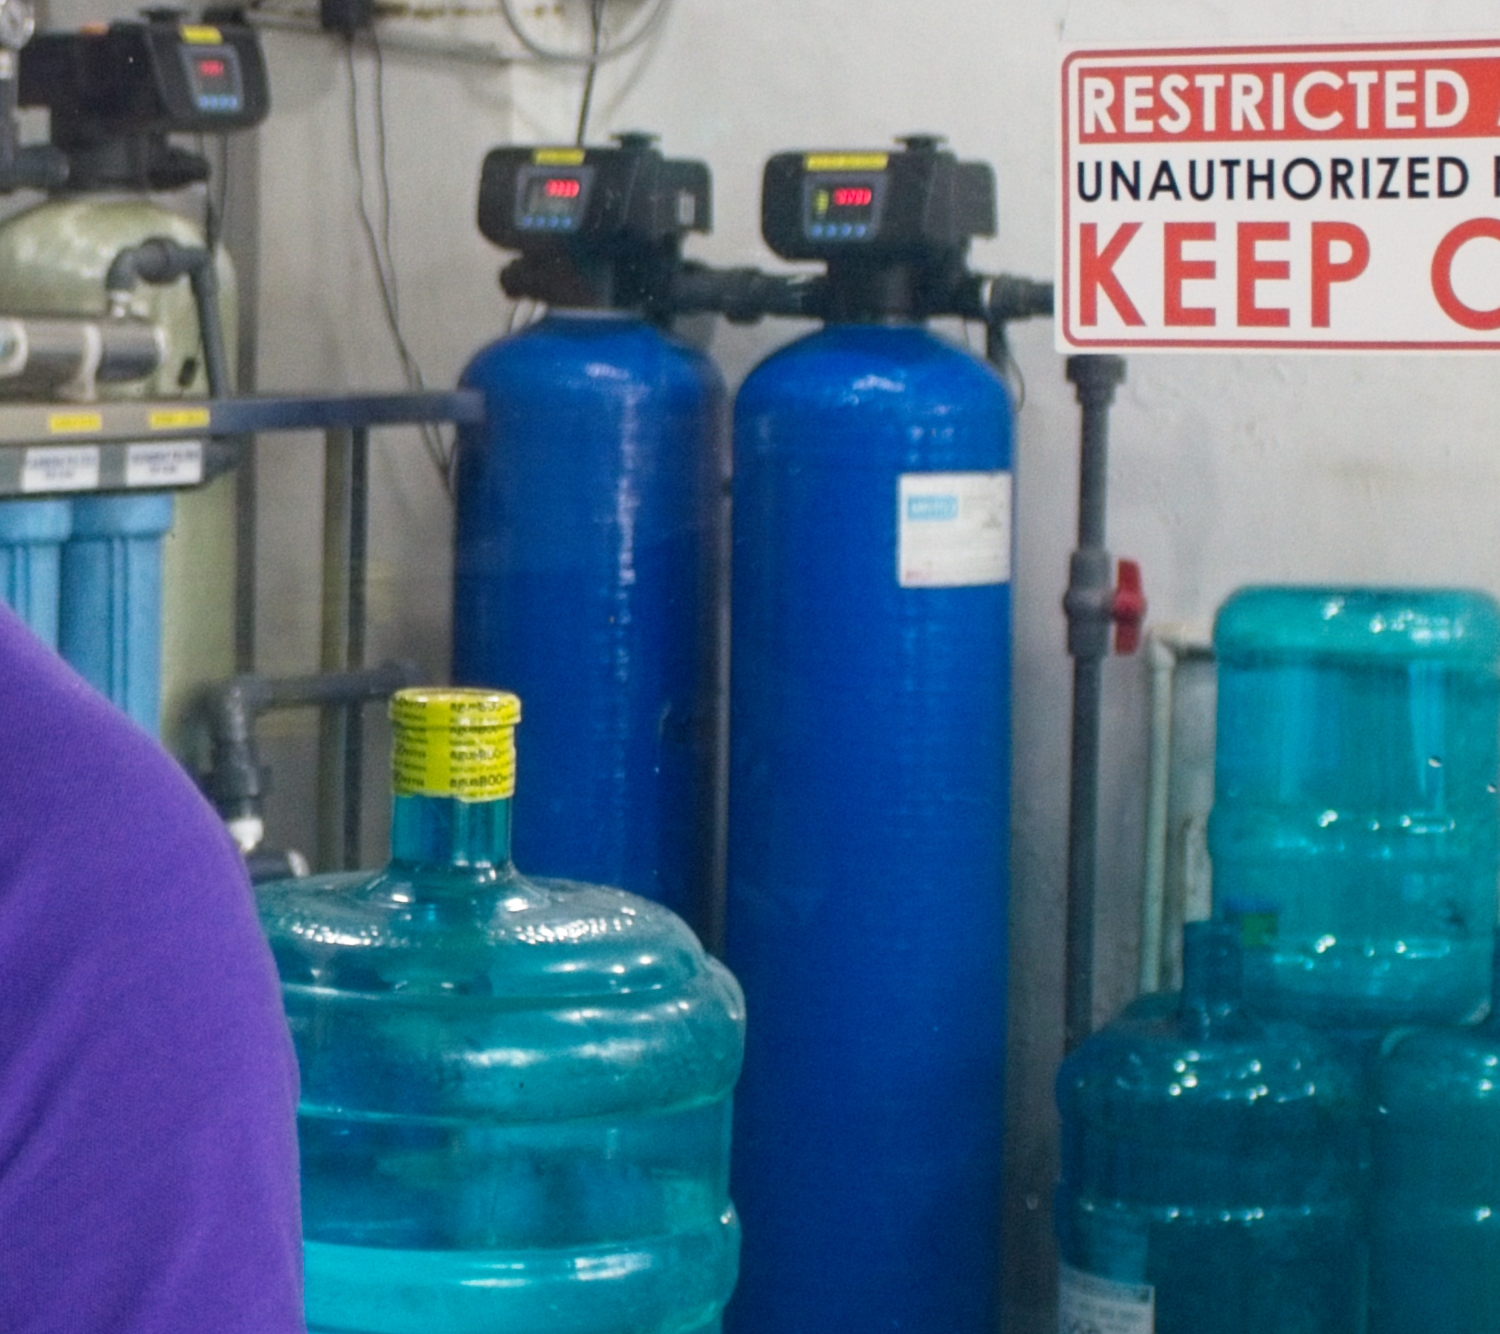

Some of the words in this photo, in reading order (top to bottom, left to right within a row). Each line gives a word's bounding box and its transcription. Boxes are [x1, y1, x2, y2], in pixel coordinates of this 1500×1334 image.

[1082, 70, 1470, 134] RESTRICTED
[1077, 156, 1469, 203] UNAUTHORIZED
[1079, 221, 1372, 328] KEEP
